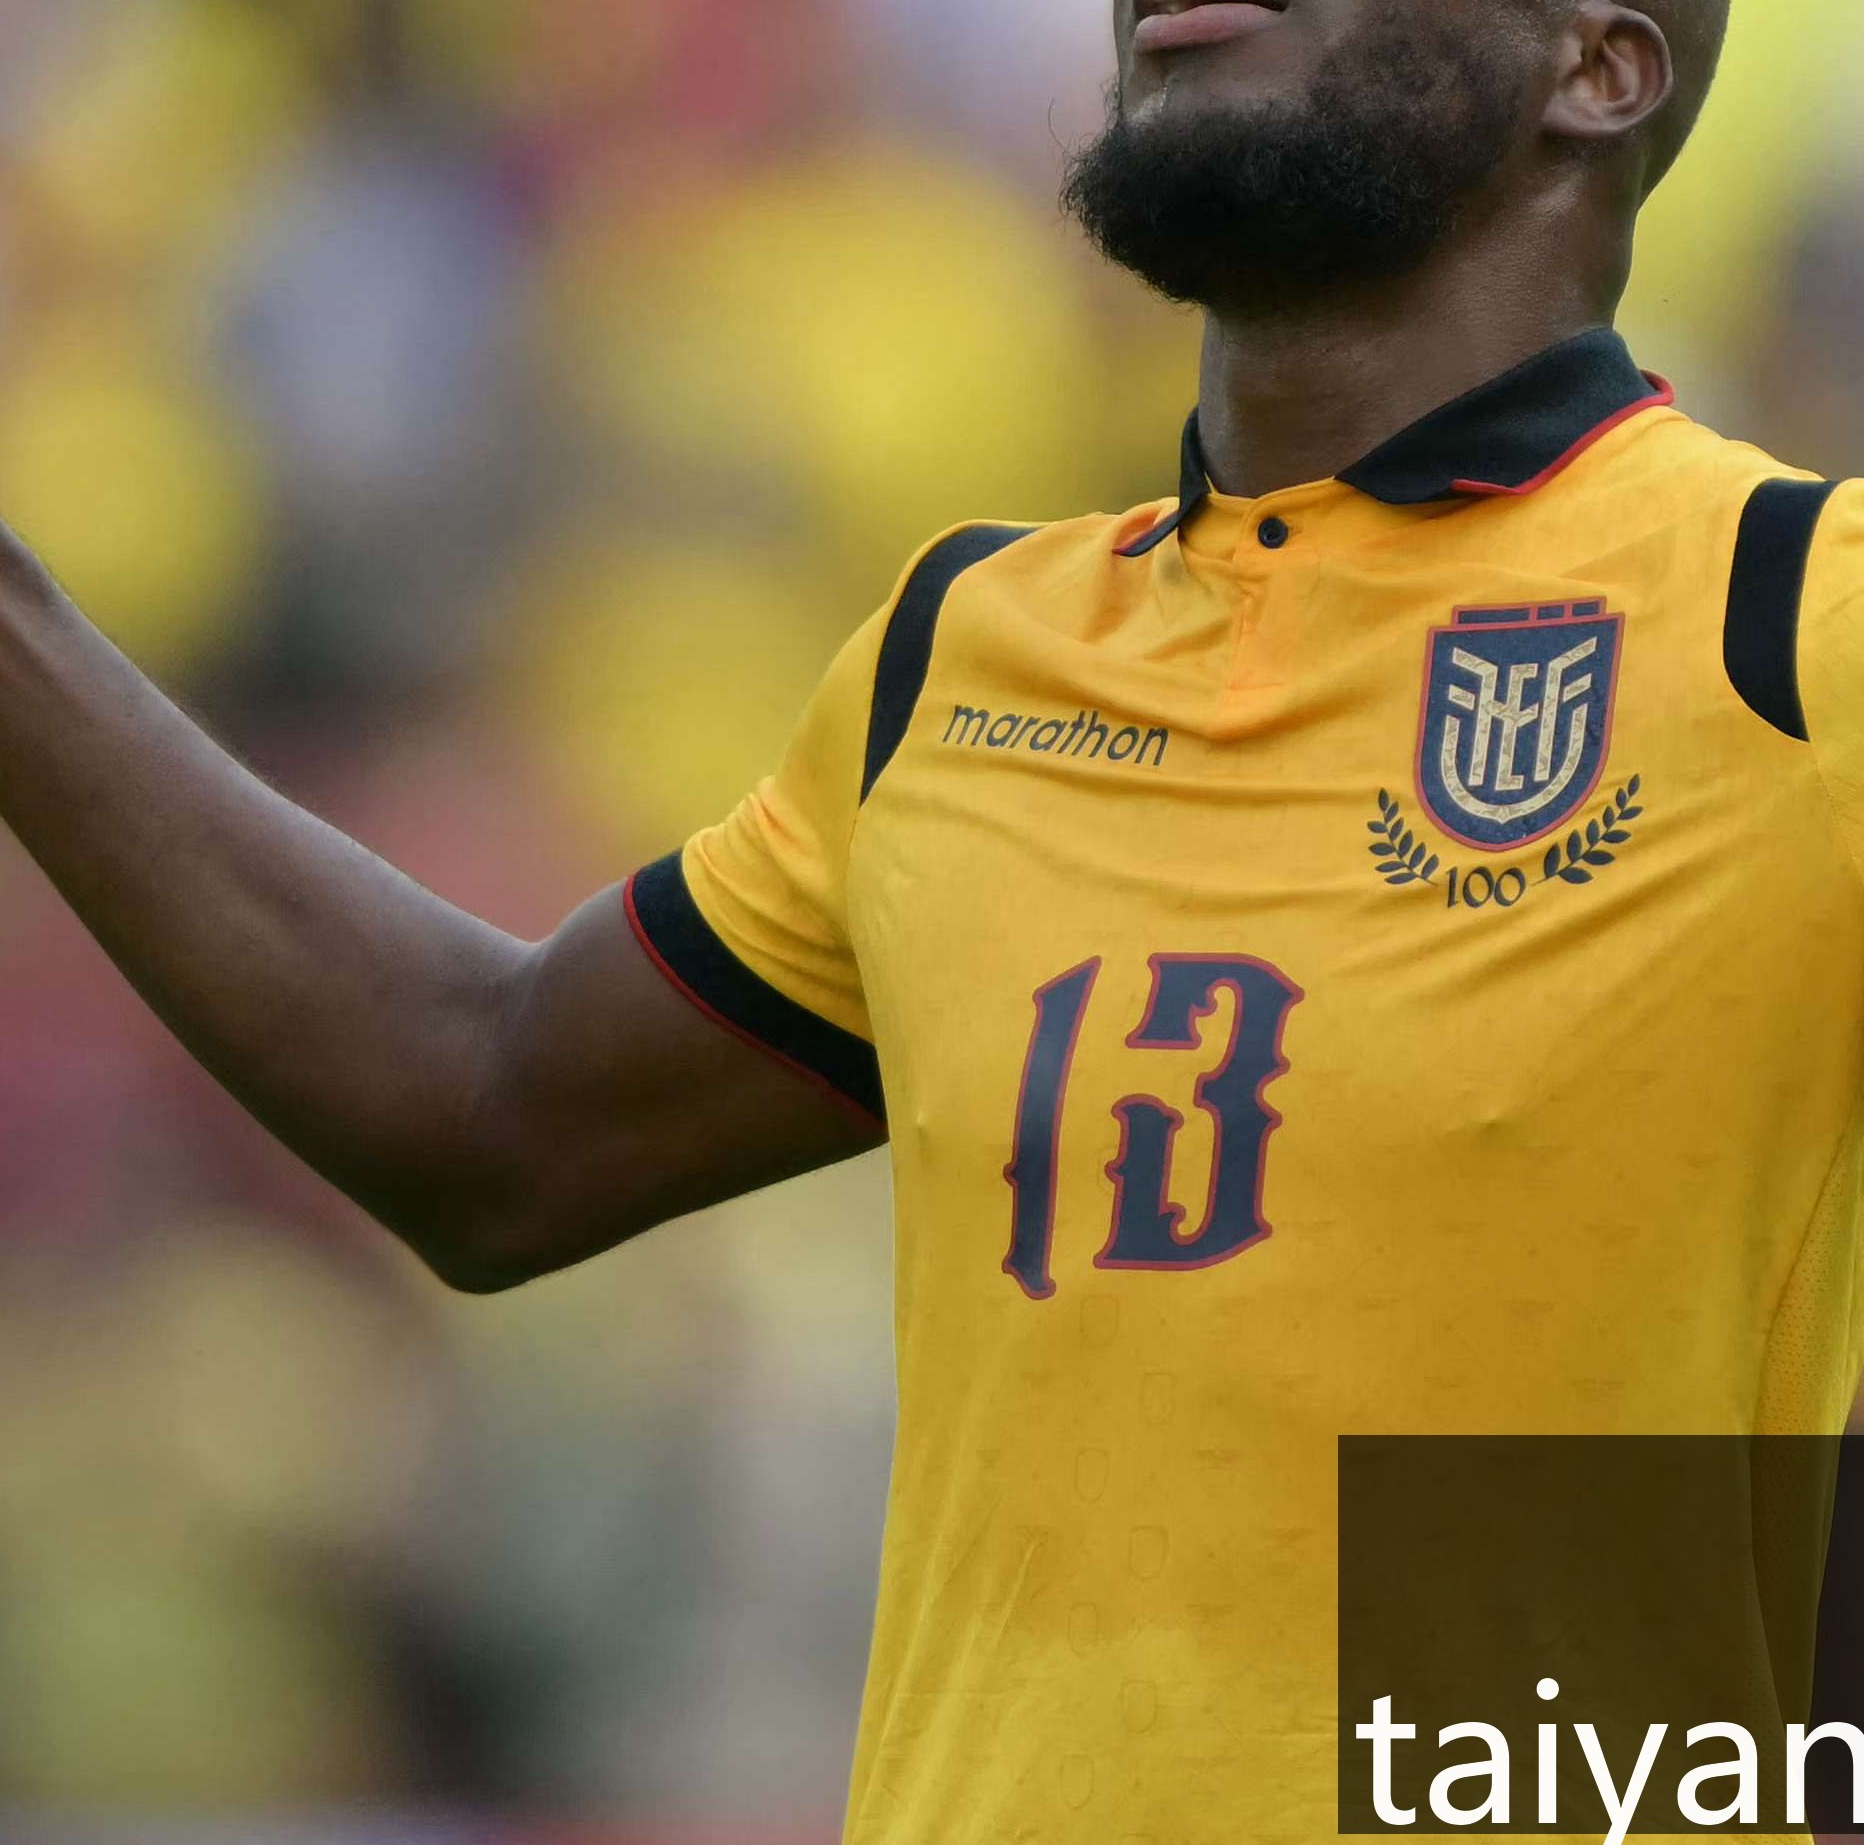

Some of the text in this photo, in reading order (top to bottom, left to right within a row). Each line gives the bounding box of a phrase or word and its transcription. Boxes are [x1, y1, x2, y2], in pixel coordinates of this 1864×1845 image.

[942, 705, 1169, 766] marathon
[1445, 866, 1526, 908] 100
[1002, 952, 1304, 1300] 13
